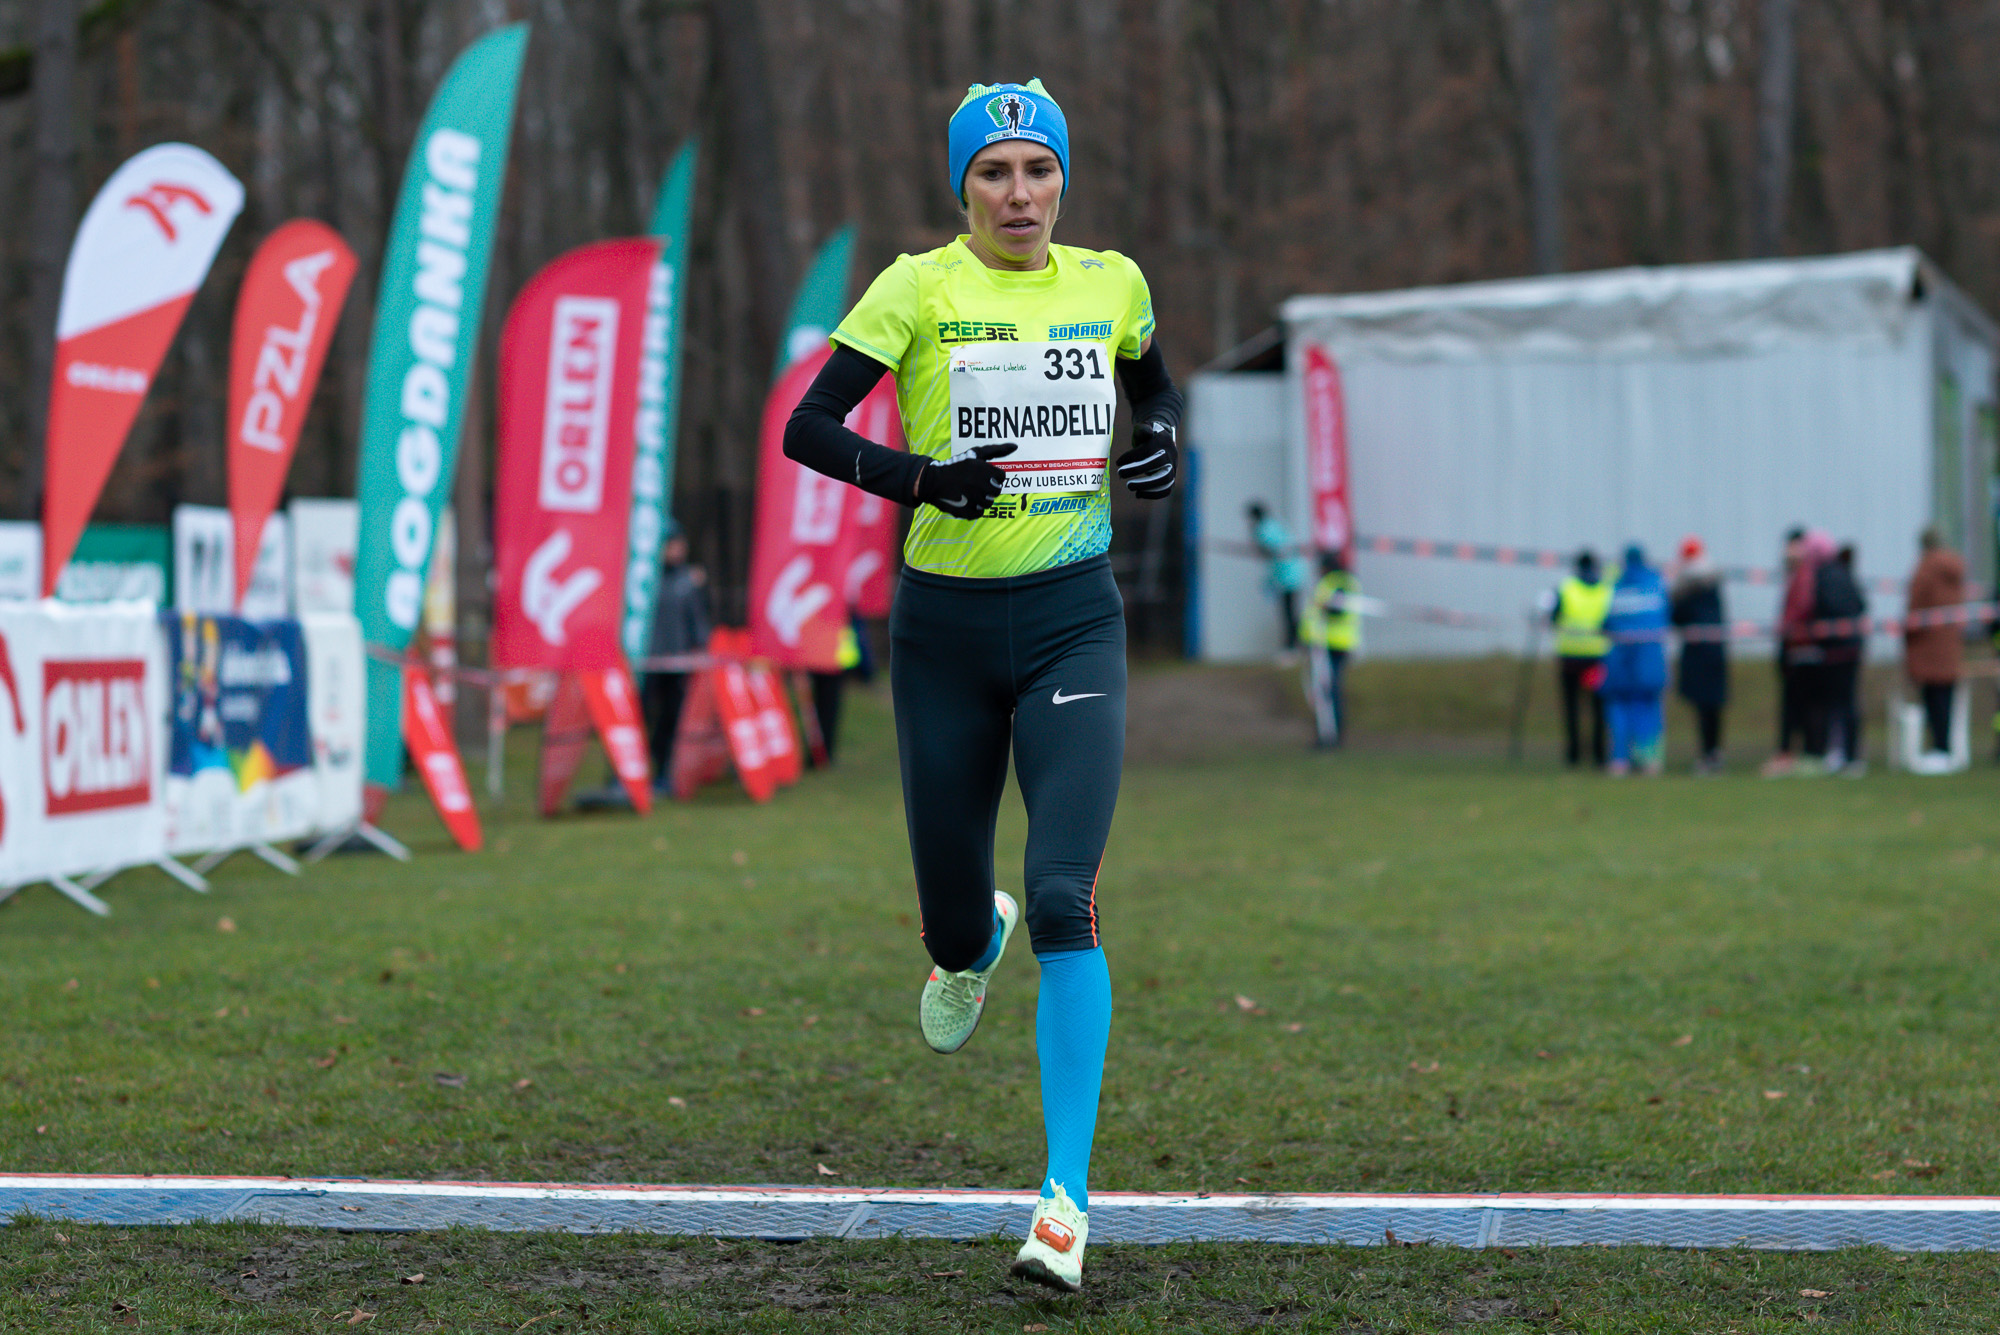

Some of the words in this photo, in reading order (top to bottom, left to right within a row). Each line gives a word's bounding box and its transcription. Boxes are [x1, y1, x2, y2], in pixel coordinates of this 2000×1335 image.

[241, 250, 336, 453] PZLA
[1043, 348, 1105, 380] 331
[1048, 321, 1114, 341] SONAROL
[385, 127, 482, 629] BOGDANKA
[555, 314, 605, 495] ORLEN
[957, 403, 1111, 439] BERNARDELLI
[1036, 474, 1088, 487] LUBELSKI
[46, 676, 149, 801] ORLEN
